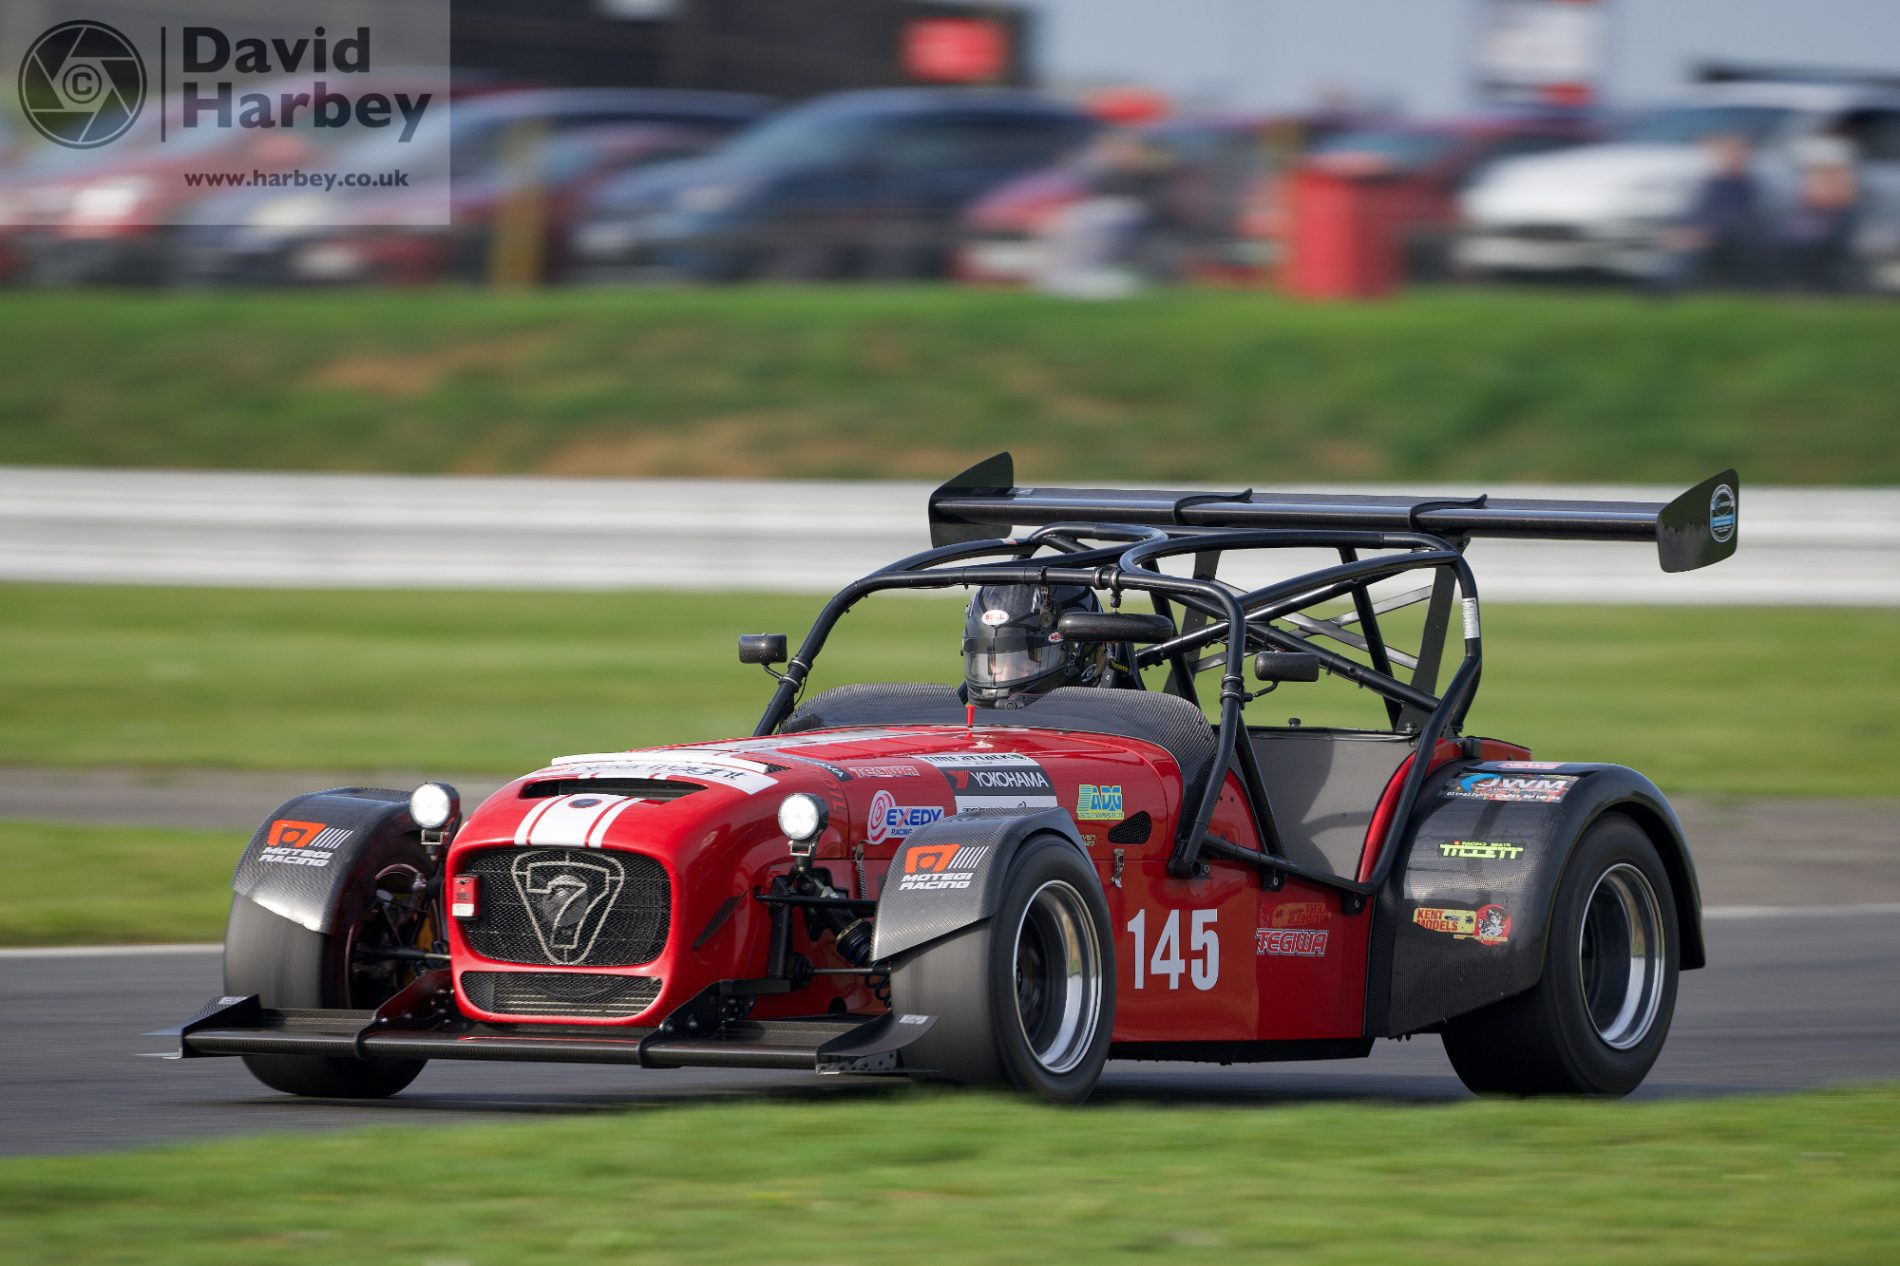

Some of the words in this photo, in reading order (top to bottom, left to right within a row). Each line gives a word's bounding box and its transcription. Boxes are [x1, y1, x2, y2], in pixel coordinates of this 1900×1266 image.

[970, 771, 1049, 788] YOKOHAMA
[886, 808, 942, 826] EXEDY
[262, 847, 334, 859] MOTEGI
[259, 854, 330, 867] RACING
[902, 872, 973, 883] MOTEGI
[899, 880, 971, 891] RACING
[1417, 910, 1444, 920] KENT
[1416, 920, 1459, 931] MODELS
[1255, 928, 1329, 957] TEGIWA
[1127, 908, 1220, 991] 145
